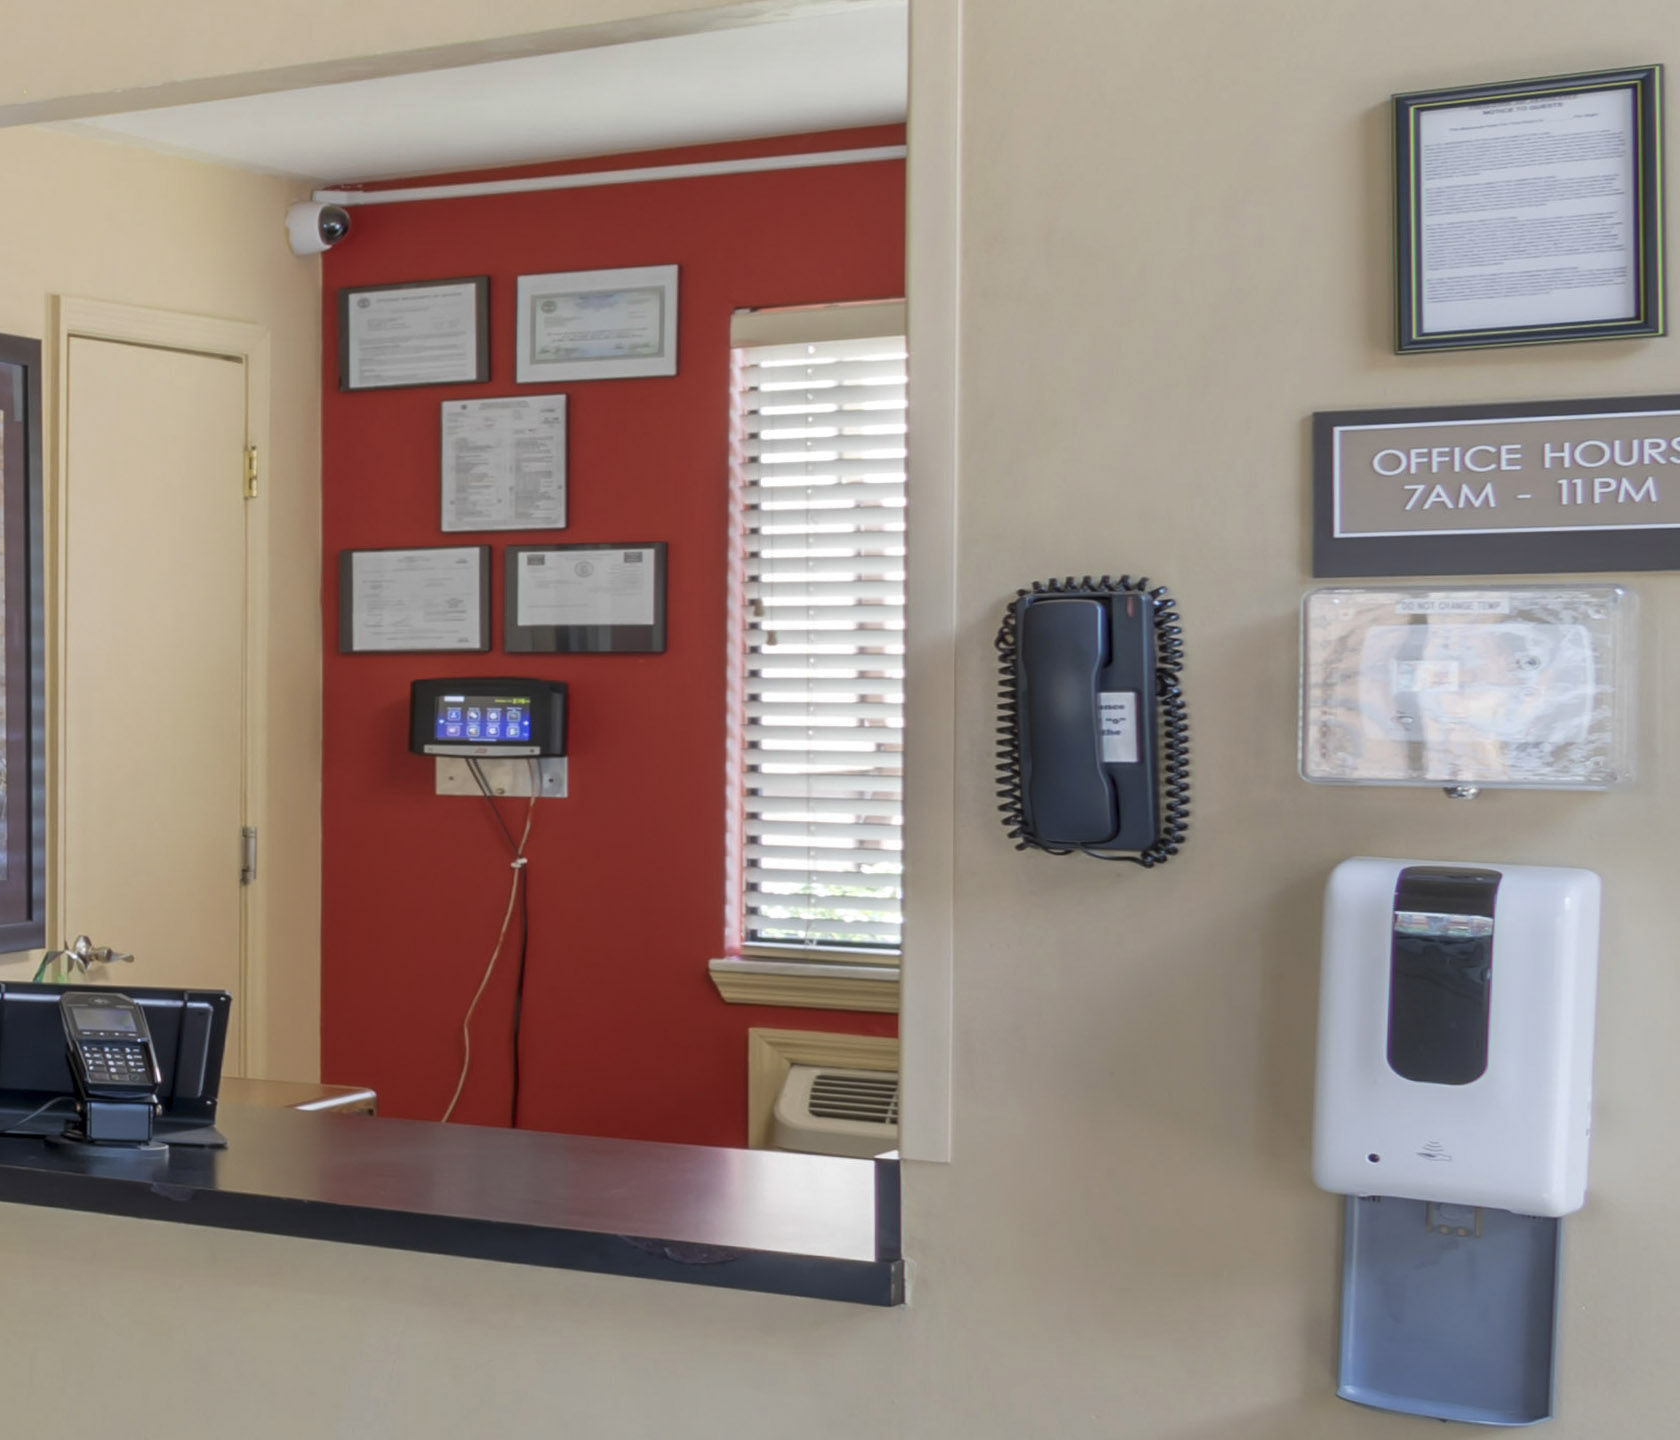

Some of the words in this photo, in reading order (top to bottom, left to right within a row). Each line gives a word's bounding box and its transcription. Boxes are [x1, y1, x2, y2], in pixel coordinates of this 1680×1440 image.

[1372, 444, 1522, 476] OFFICE
[1403, 482, 1497, 511] 7AM
[1557, 476, 1658, 505] 11PM
[1400, 600, 1415, 611] DO
[1417, 600, 1435, 611] NOT
[1438, 600, 1474, 611] CHANGE
[1477, 600, 1501, 611] TEMP
